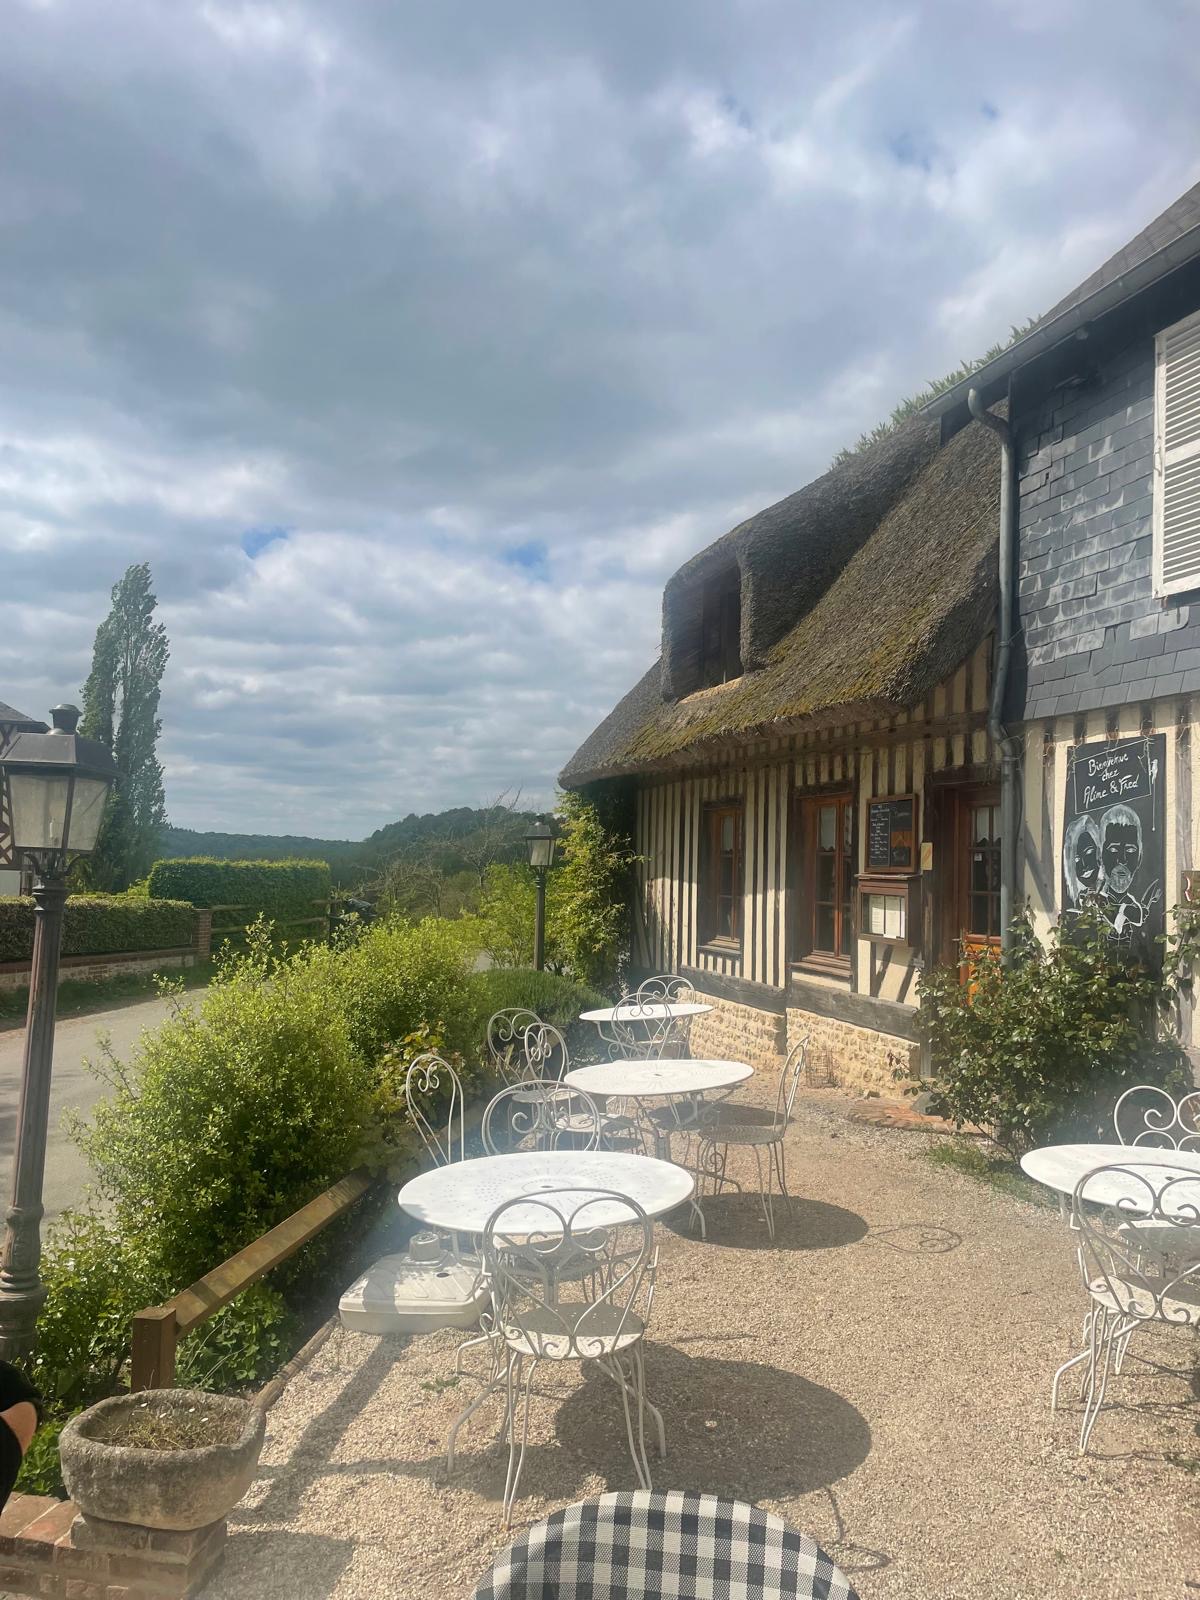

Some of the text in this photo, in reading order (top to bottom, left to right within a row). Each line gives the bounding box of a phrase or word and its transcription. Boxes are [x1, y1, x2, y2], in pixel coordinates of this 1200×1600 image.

[1088, 753, 1129, 777] Bienvenue
[1099, 768, 1120, 782] chez
[1083, 774, 1139, 809] Aline & Fred
